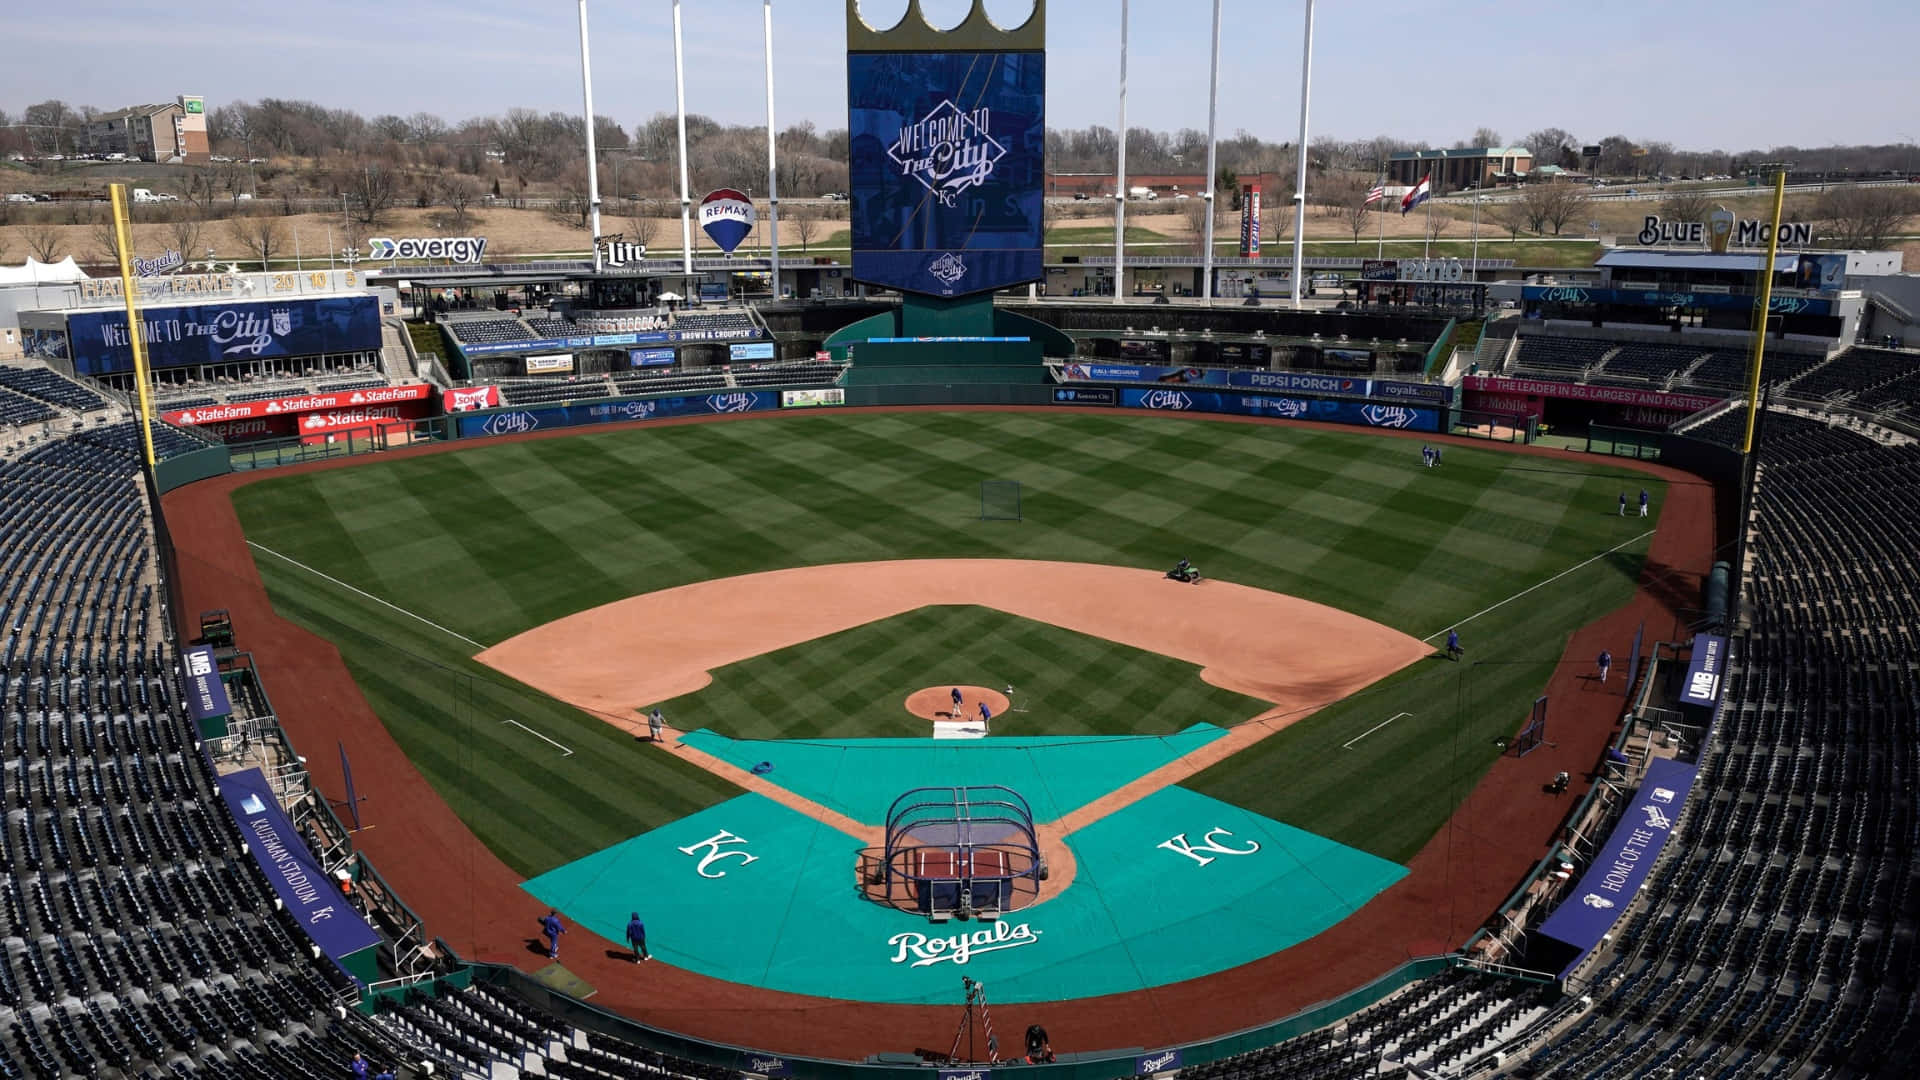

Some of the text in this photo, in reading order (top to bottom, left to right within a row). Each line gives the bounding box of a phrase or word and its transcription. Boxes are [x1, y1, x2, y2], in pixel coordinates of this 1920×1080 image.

[900, 107, 990, 154] WELCOME TO
[901, 141, 993, 187] THE City
[938, 189, 957, 209] KC
[706, 206, 748, 217] RE/MAX
[1639, 215, 1812, 246] BLUE MOON
[400, 239, 485, 263] evergy
[608, 241, 647, 268] Lite
[132, 250, 183, 278] Royals
[1400, 262, 1463, 281] PATIO
[81, 278, 146, 299] HALL
[171, 273, 234, 295] FAME
[273, 274, 295, 290] 20
[309, 272, 327, 288] 10
[345, 271, 357, 287] 5
[101, 310, 272, 355] WELOME TO THE City
[681, 331, 706, 340] BROWN
[1251, 374, 1339, 391] PEPSI PORCH
[1385, 385, 1443, 398] royals.com
[457, 395, 484, 405] SONIC
[1150, 389, 1183, 409] City
[1488, 398, 1527, 413] Mobile
[1495, 380, 1515, 391] THE
[1517, 381, 1556, 395] LEADER
[1558, 386, 1570, 396] IN
[1571, 386, 1588, 398] 5G.
[1590, 390, 1637, 401] LARGEST
[1639, 393, 1662, 405] AND
[1663, 396, 1712, 410] FASTEST
[493, 412, 529, 435] City
[190, 651, 212, 677] UMB
[1688, 672, 1714, 699] UMB
[677, 829, 759, 878] KC
[1156, 827, 1260, 867] KC
[250, 818, 335, 925] KAUFFMAN STADIUM KC
[1600, 828, 1655, 893] HOME OF THE
[888, 920, 1038, 969] Royals
[751, 1057, 785, 1073] Royals
[1143, 1052, 1176, 1073] Royals
